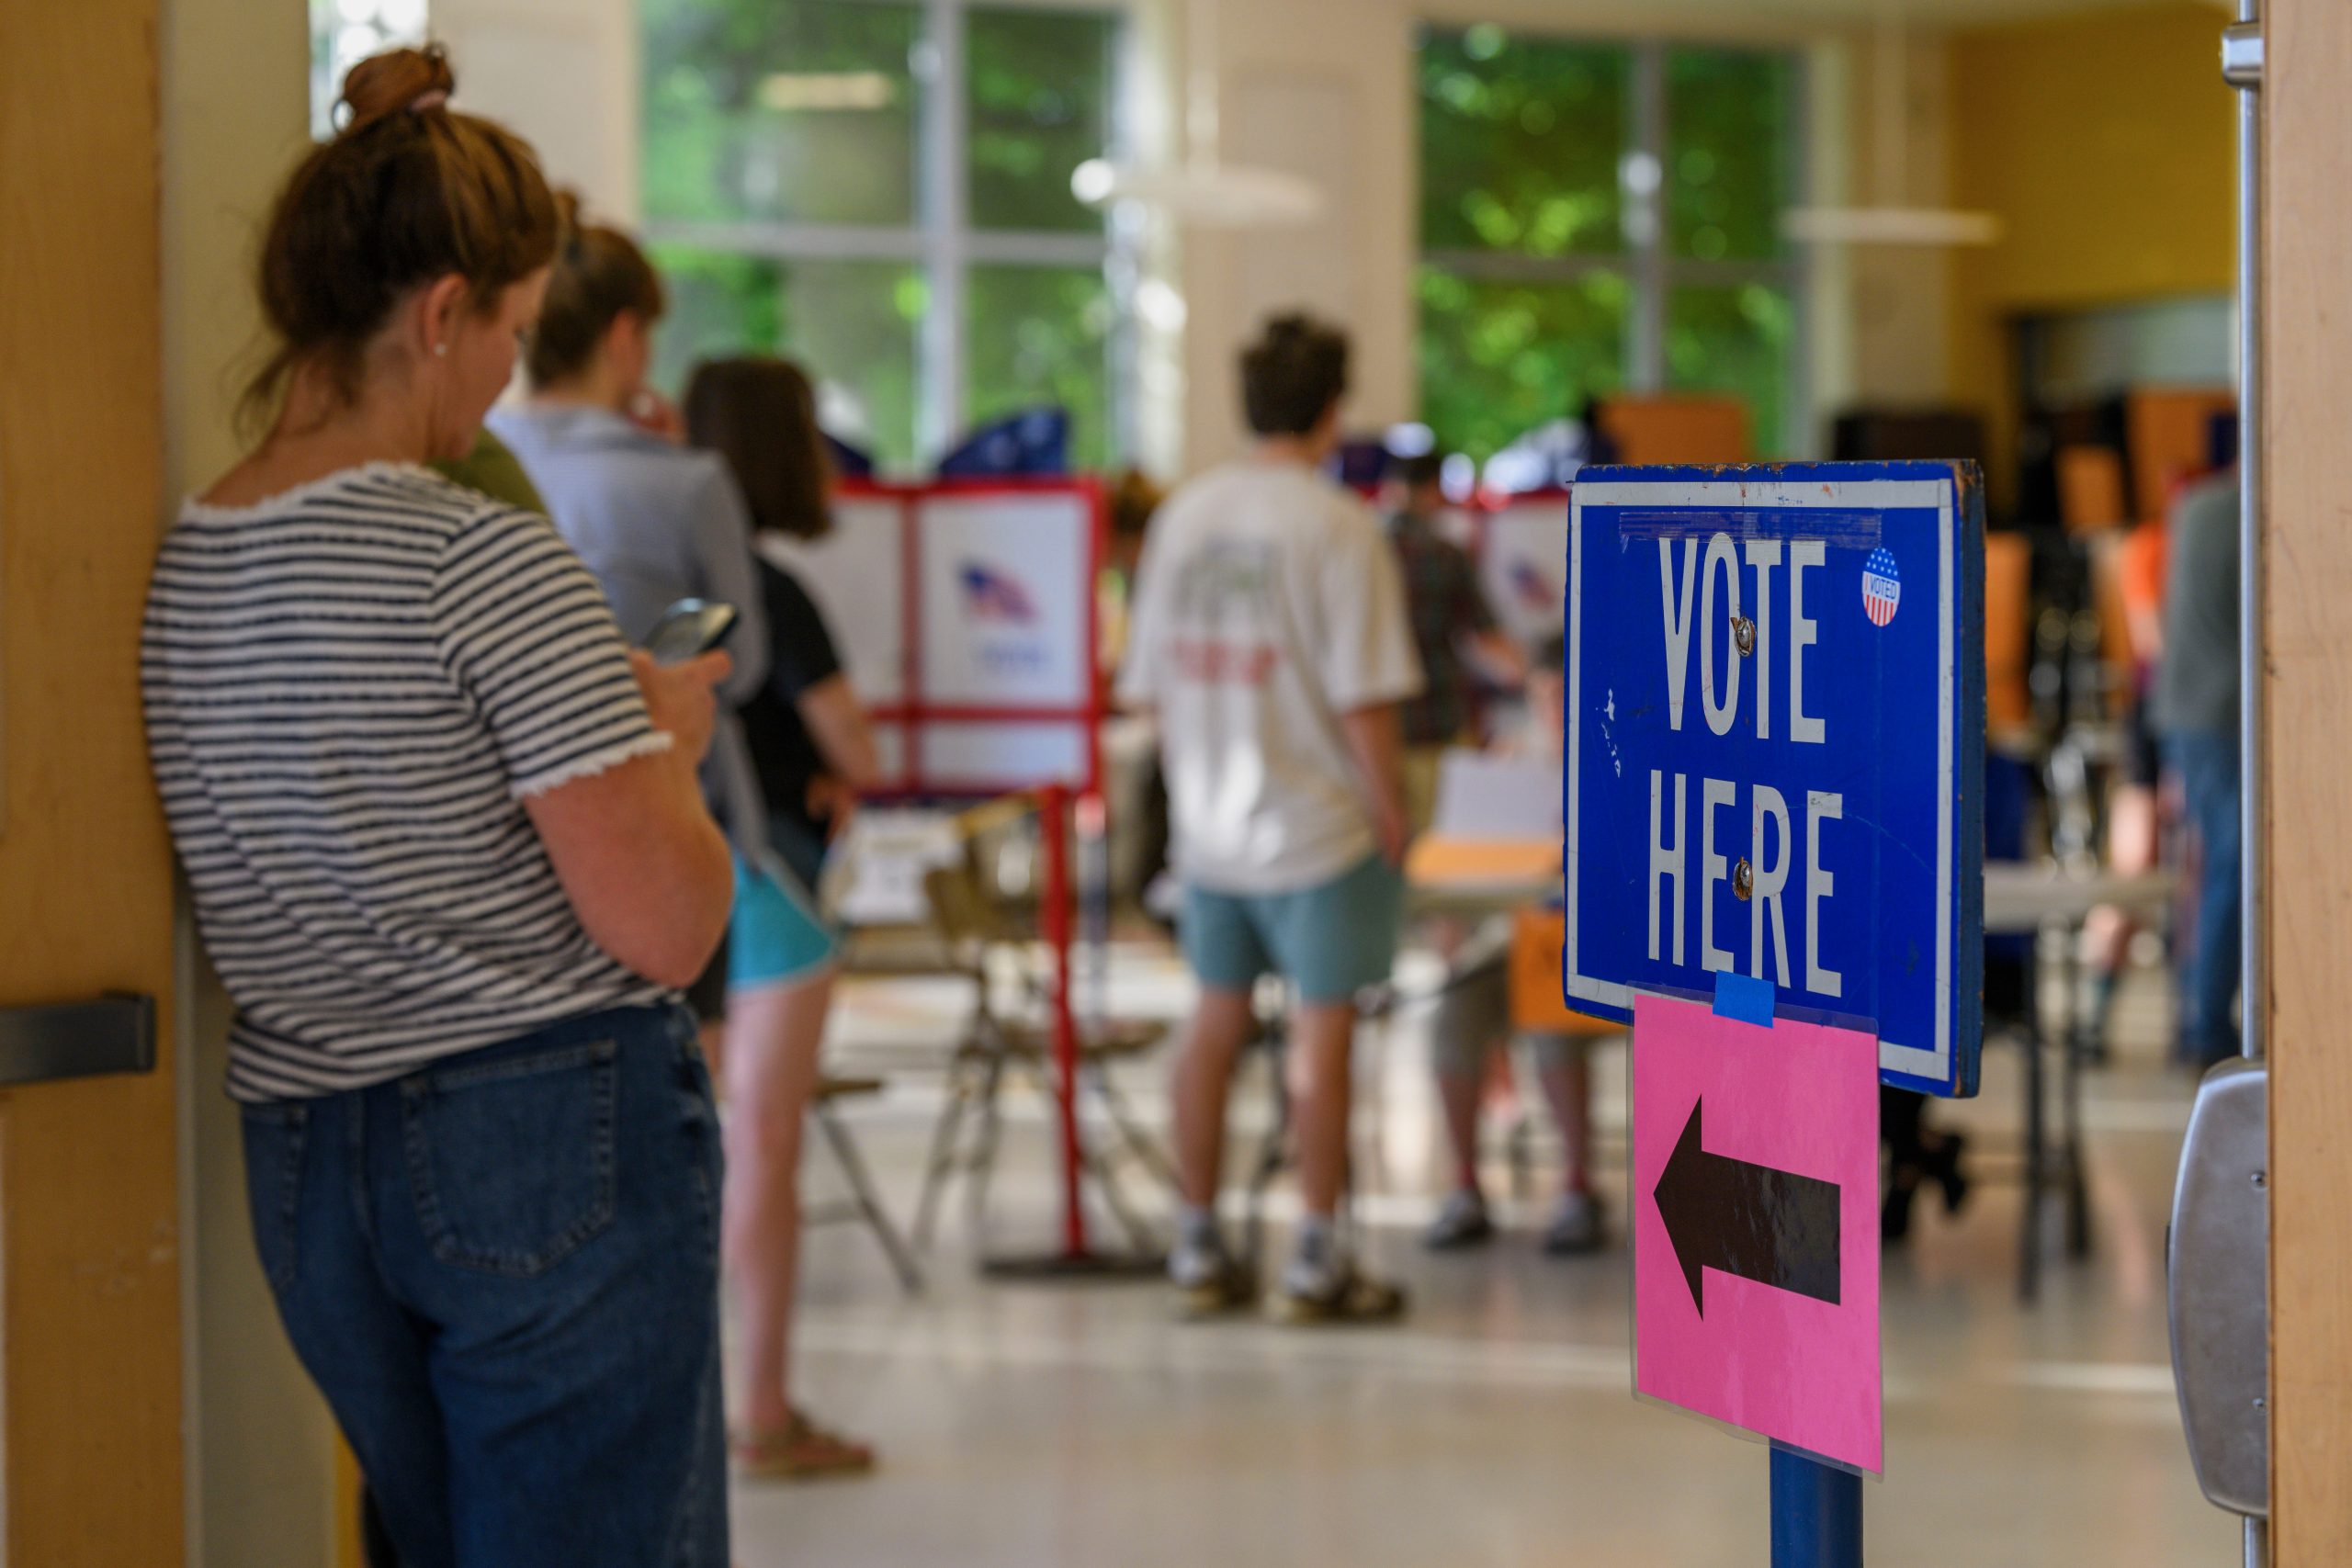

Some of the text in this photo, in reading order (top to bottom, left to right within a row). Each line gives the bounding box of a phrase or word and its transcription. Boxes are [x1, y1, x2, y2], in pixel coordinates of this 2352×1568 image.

[1658, 532, 1826, 744] VOTE
[1871, 577, 1896, 600] VOTED
[1648, 769, 1843, 998] HERE
